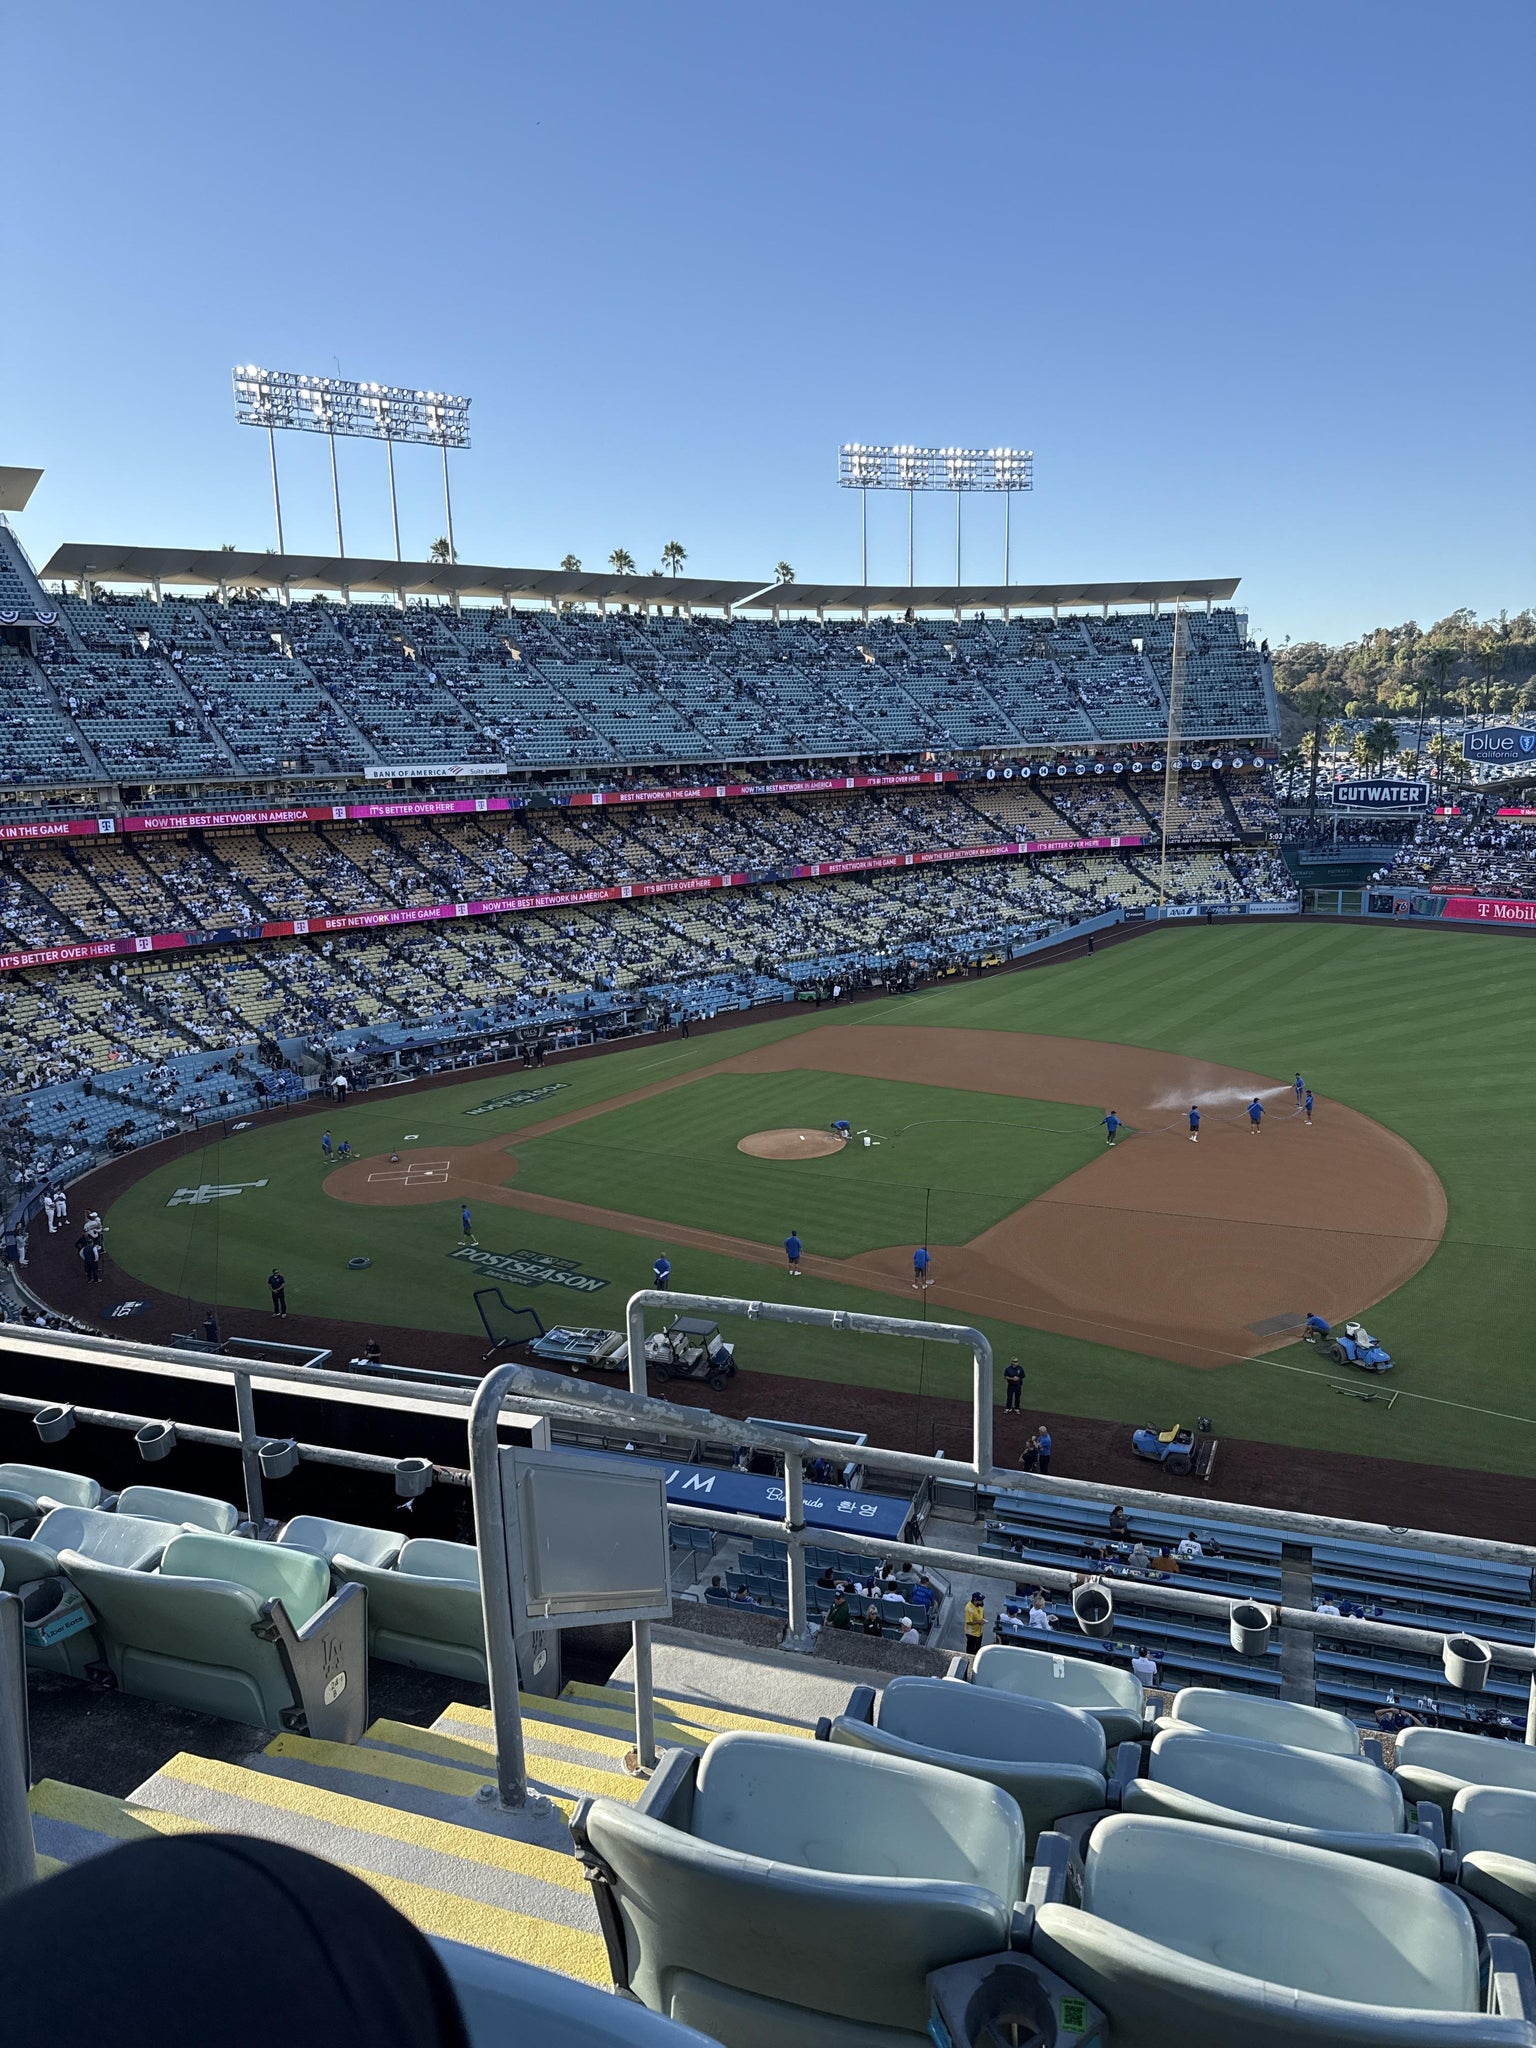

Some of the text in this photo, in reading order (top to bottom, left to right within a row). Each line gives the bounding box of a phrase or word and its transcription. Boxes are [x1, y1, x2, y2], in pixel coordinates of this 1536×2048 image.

[1470, 734, 1514, 750] blue
[766, 784, 778, 792] BEST
[779, 784, 804, 792] NETWORK
[810, 782, 832, 790] AMERICA
[896, 776, 908, 784] OVER
[620, 793, 634, 801] BEST
[636, 792, 665, 801] NETWORK
[684, 790, 700, 798] GAME
[1338, 788, 1420, 801] CUTWATER
[370, 803, 454, 814] IT'S BETTER OVER HERE
[145, 810, 308, 828] NOW THE BEST NETWORK IN AMERICA
[6, 828, 17, 836] IN
[18, 826, 38, 836] THE
[38, 824, 70, 834] GAME
[1048, 842, 1068, 850] BETTER
[1068, 840, 1084, 848] OVER
[956, 850, 979, 859] NETWORK
[985, 846, 1008, 855] AMERICA
[829, 864, 840, 872] BEST
[842, 861, 866, 871] NETWORK
[883, 858, 897, 866] GAME
[644, 880, 711, 894] IT'S BETTER OVER HERE
[482, 890, 609, 912] NOW THE BEST NETWORK IN AMERICA
[326, 908, 441, 928] BEST NETWORK IN THE GAME
[0, 944, 116, 968] IT'S BETTER OVER HERE
[451, 1248, 605, 1292] POSTSEASON
[836, 1500, 878, 1516] 환영
[46, 1616, 84, 1638] Uber Eats
